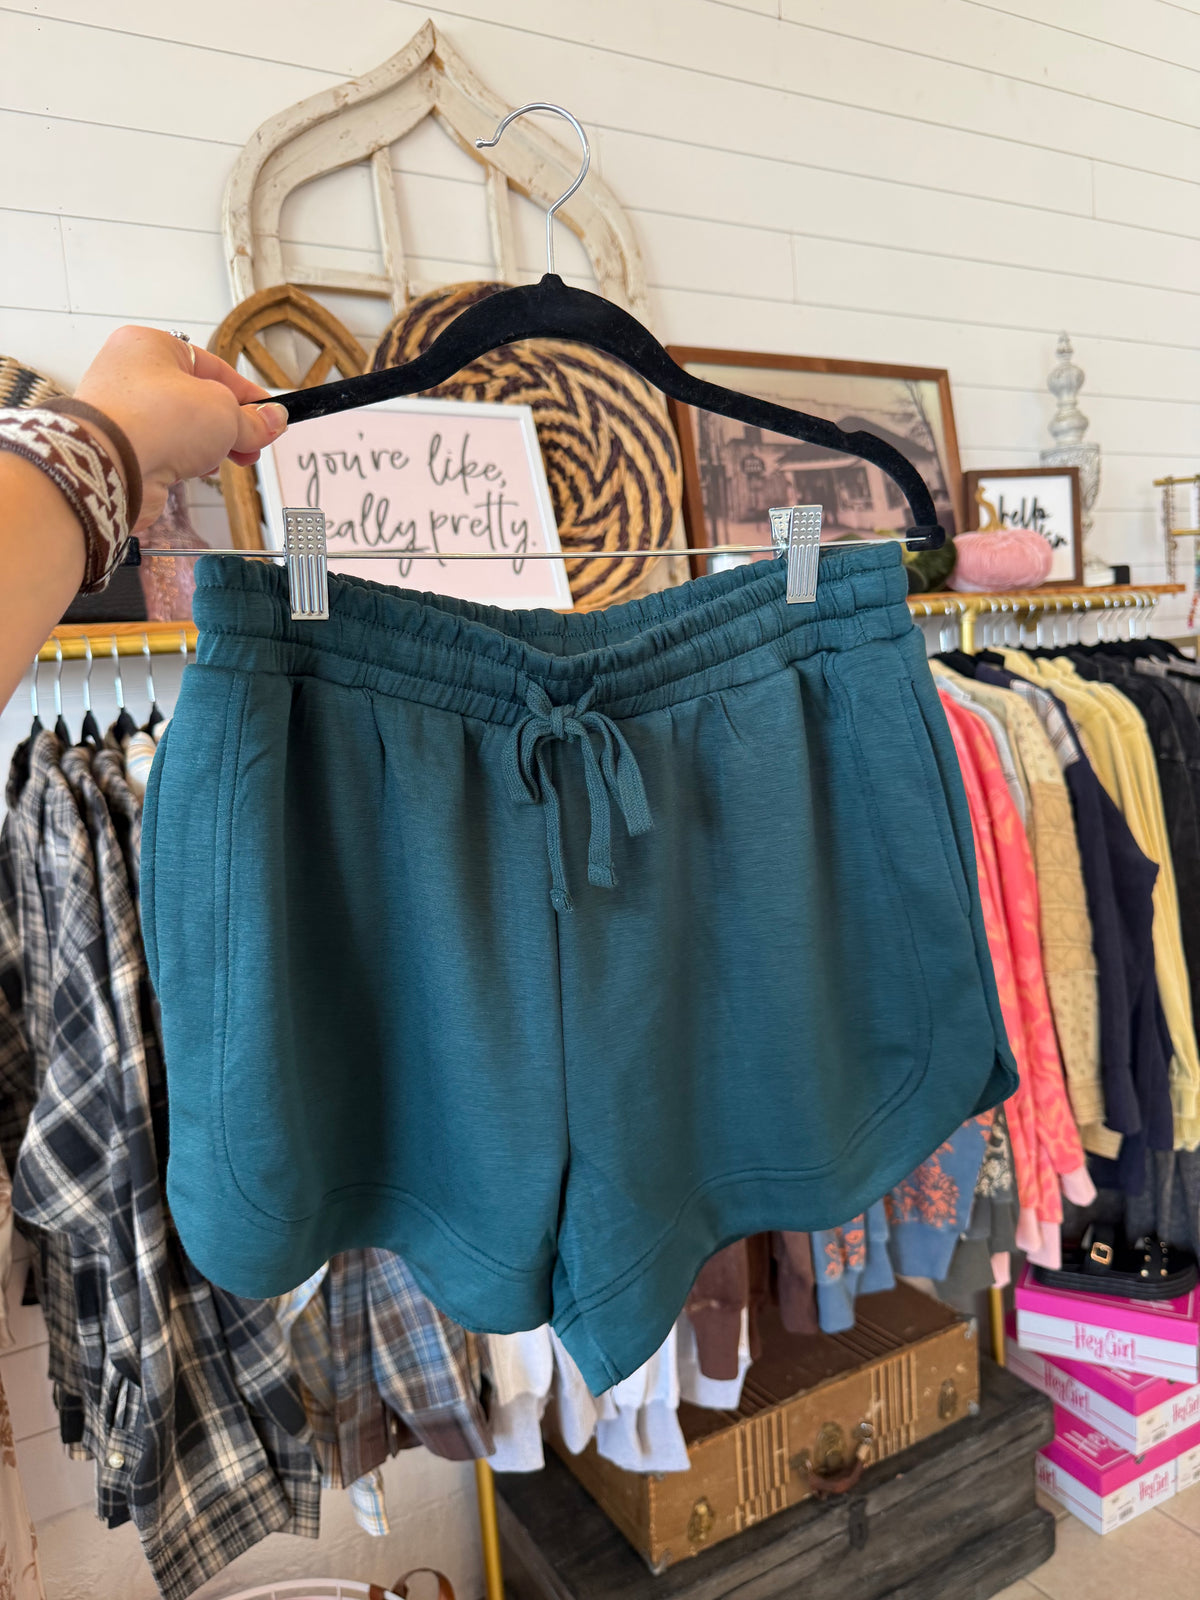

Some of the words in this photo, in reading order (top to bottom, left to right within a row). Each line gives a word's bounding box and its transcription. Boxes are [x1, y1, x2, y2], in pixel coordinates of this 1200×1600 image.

[298, 431, 410, 507] you're
[427, 432, 507, 494] like,
[325, 492, 427, 578] eally
[430, 491, 538, 575] pretty.
